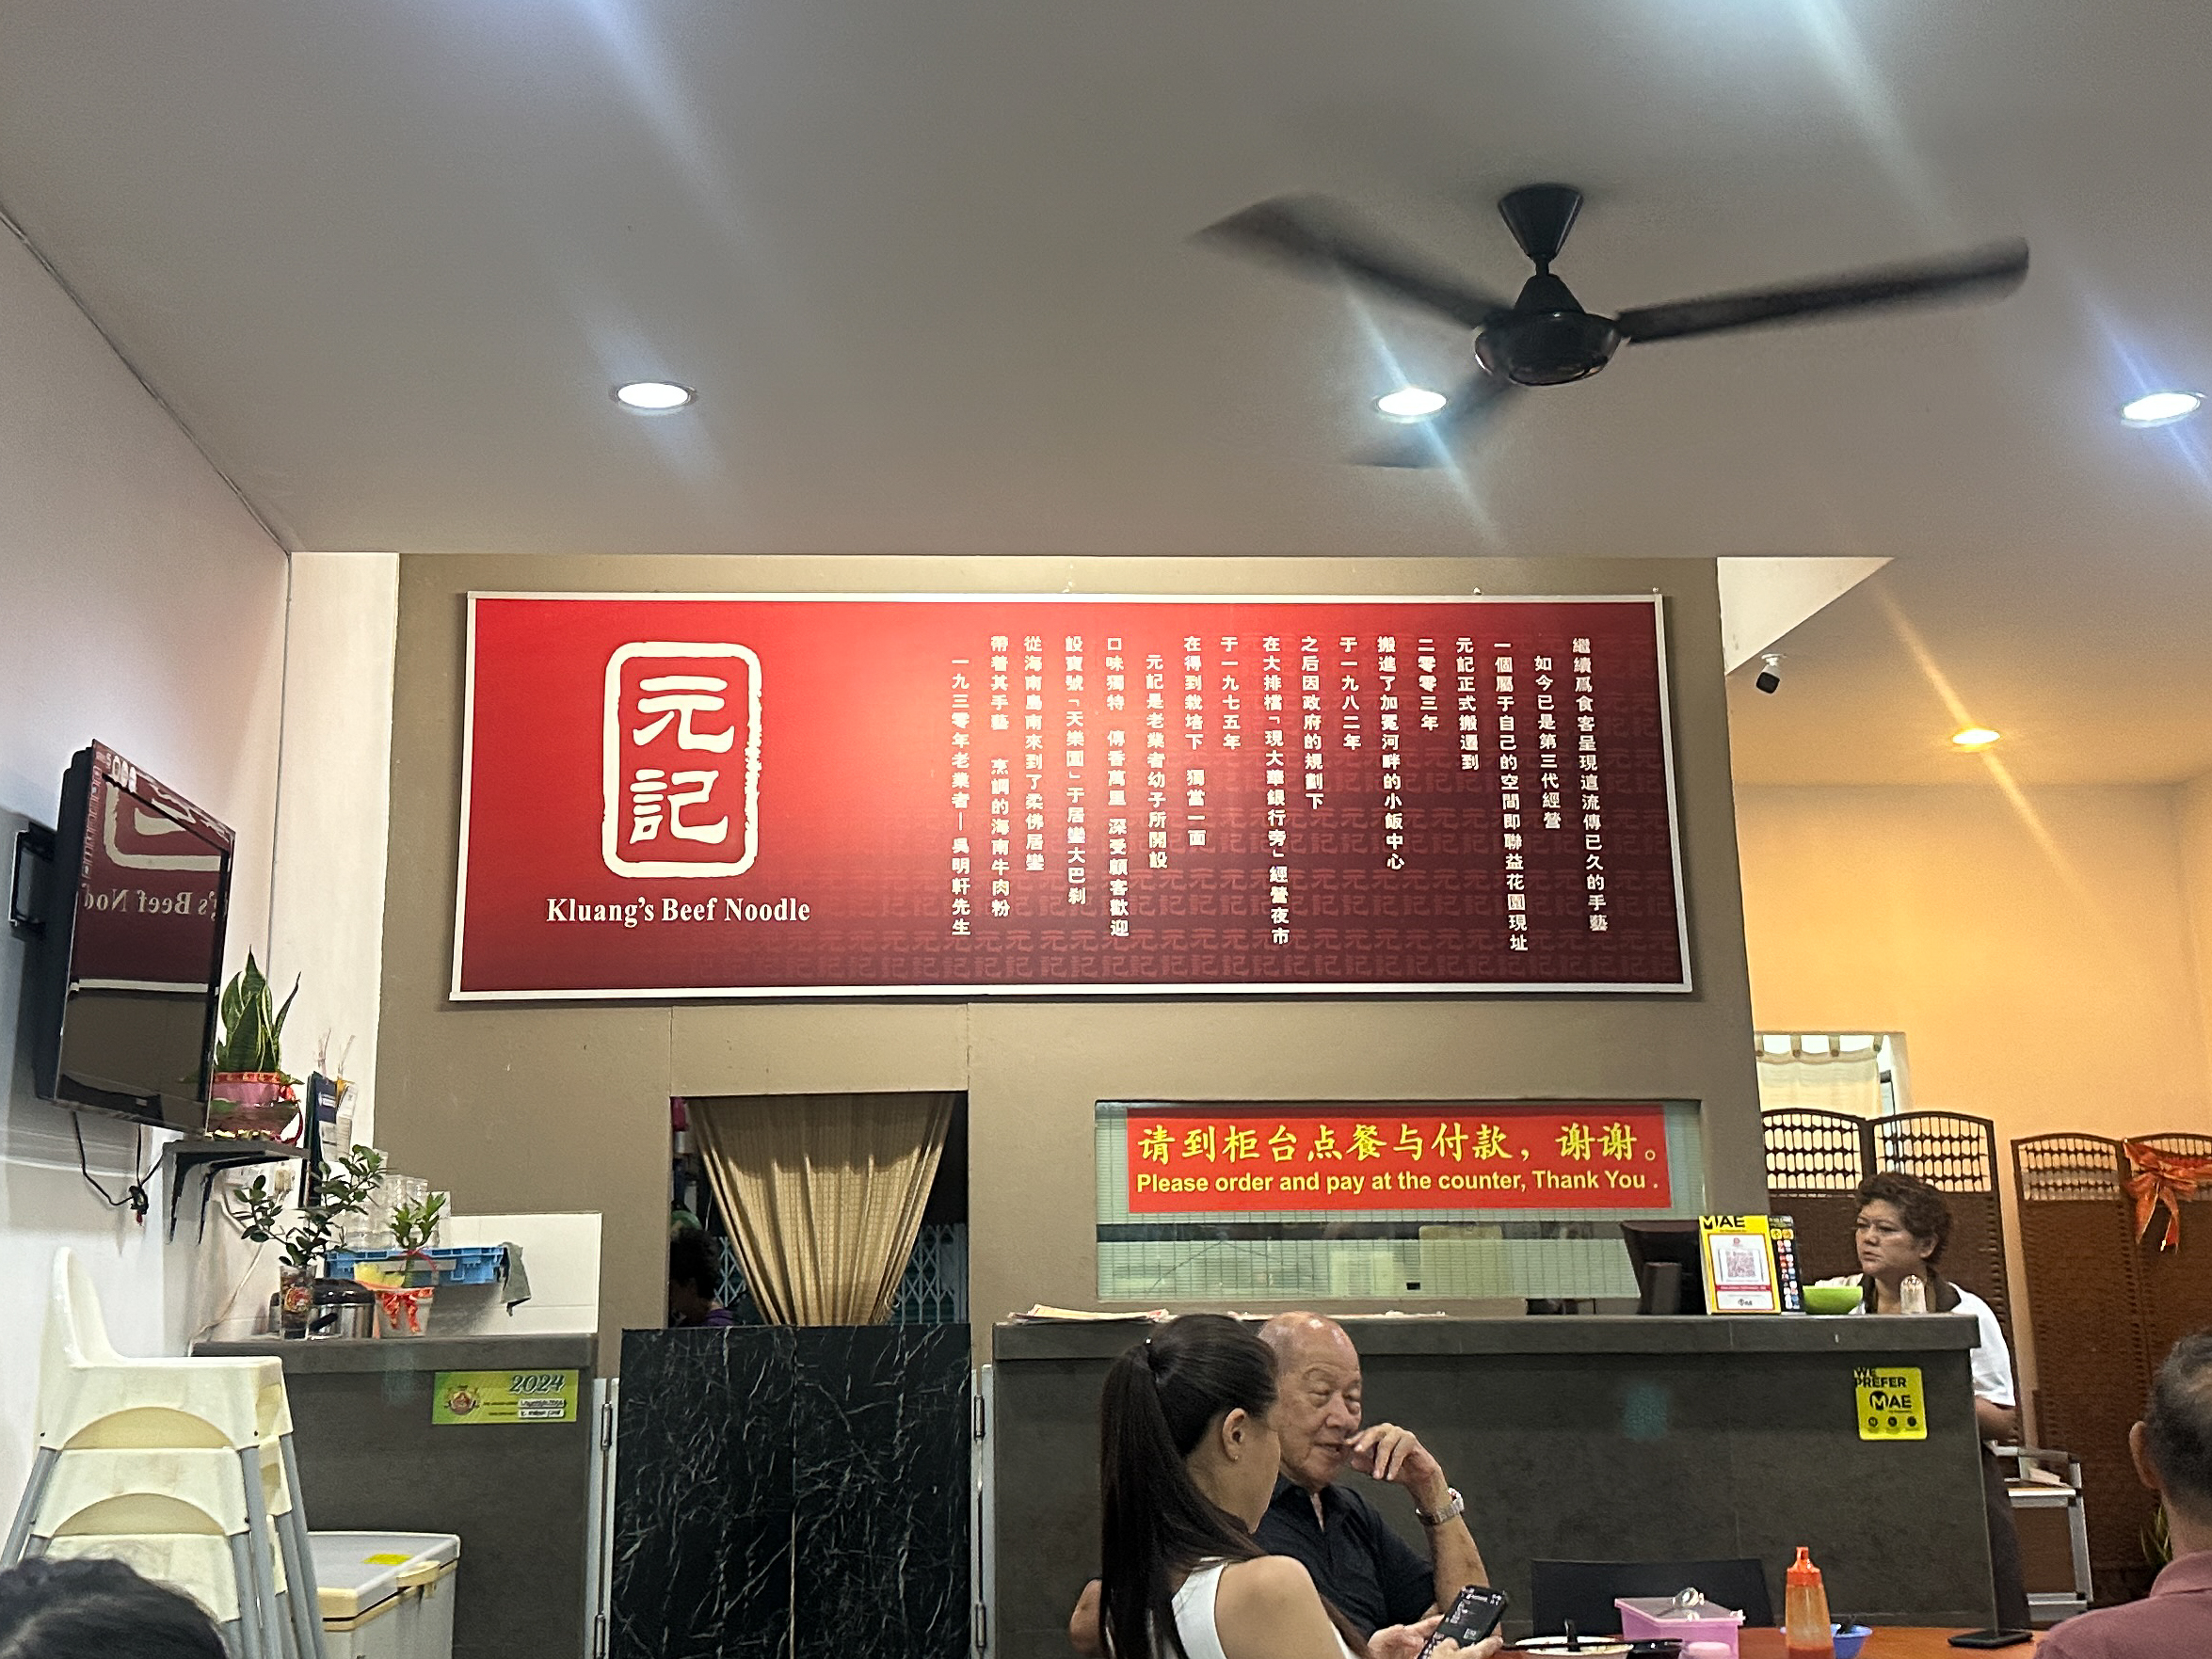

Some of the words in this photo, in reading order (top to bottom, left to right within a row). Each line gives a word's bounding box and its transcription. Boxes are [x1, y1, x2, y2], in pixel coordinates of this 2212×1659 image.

[1106, 638, 1124, 710] 口味獨特
[1184, 636, 1203, 750] 在得到栽培下
[1221, 637, 1241, 750] 于一九七五年
[1339, 637, 1361, 750] 于一九八二年
[1419, 639, 1438, 730] 二零零三年
[1456, 638, 1479, 770] 元記正式搬遷到
[630, 676, 734, 843] 元記
[1107, 730, 1126, 806] 傳香萬里
[1146, 655, 1167, 868] 元記是老業者幼子所開設
[1534, 656, 1561, 828] 如今已是第三代經營
[1185, 768, 1207, 846] 獨當一面
[662, 897, 718, 922] Beef
[725, 897, 811, 922] Noodle
[1108, 819, 1130, 937] 深受顧客歡迎
[1137, 1173, 1209, 1193] Please
[1214, 1172, 1274, 1192] order
[1279, 1172, 1320, 1191] and
[1326, 1175, 1365, 1195] pay
[1371, 1172, 1392, 1190] at
[1397, 1171, 1432, 1190] the
[1438, 1172, 1526, 1192] counter,
[1531, 1170, 1599, 1188] Thank
[509, 1373, 566, 1395] 2024
[1854, 1377, 1907, 1388] PREFER
[1868, 1390, 1913, 1411] MAE
